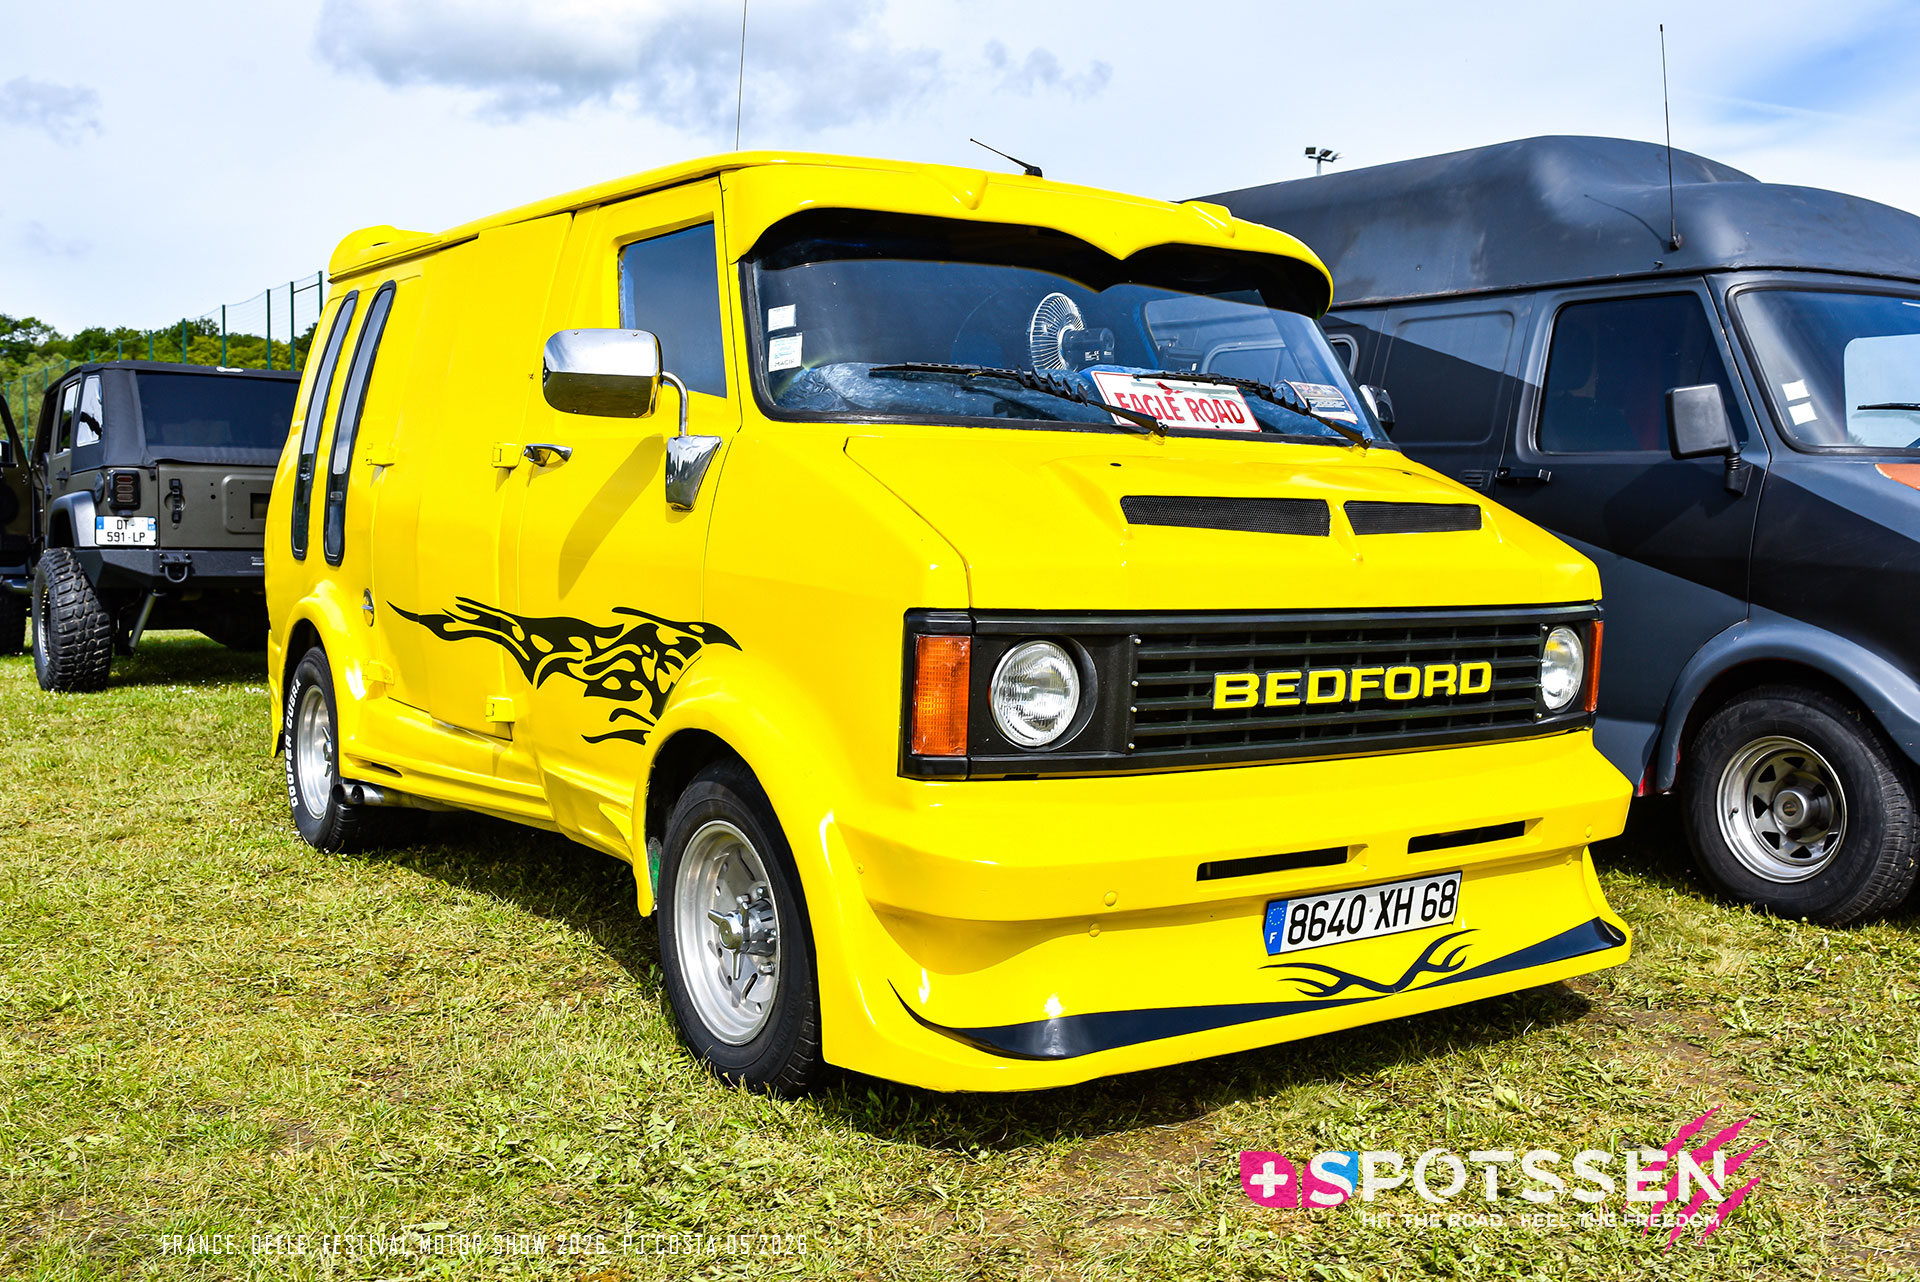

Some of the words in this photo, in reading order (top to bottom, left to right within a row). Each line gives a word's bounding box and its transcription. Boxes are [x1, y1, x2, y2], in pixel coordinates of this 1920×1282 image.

[1113, 391, 1186, 422] EAGLE
[1183, 397, 1246, 424] ROAD
[1212, 661, 1493, 710] BEDFORD
[1287, 894, 1366, 945] 8640
[1374, 886, 1415, 931] XH
[1421, 879, 1458, 922] 68
[1269, 931, 1278, 945] F
